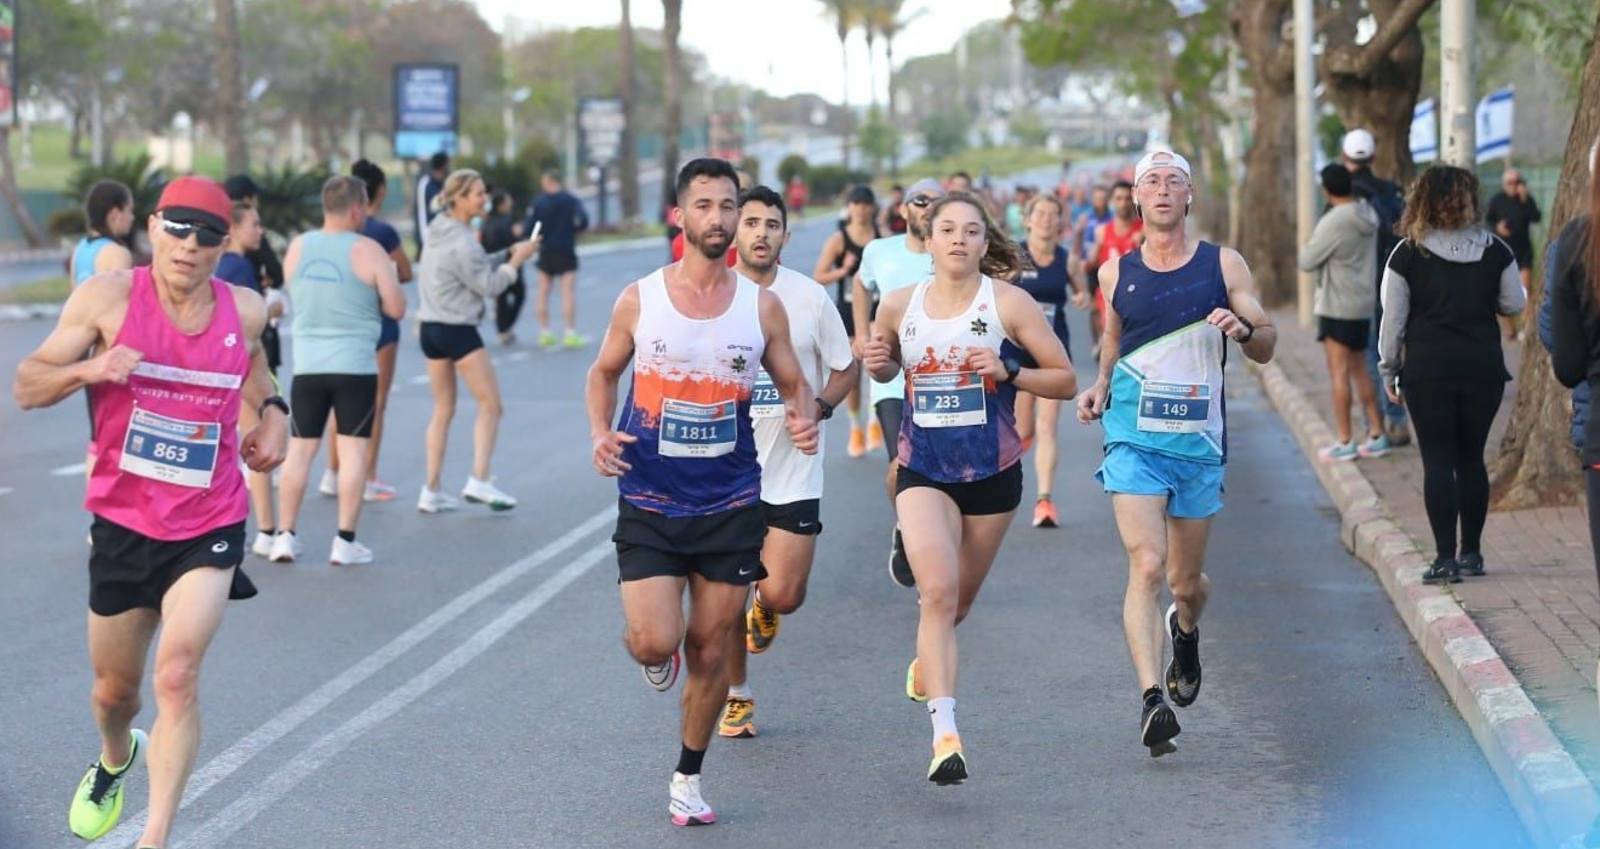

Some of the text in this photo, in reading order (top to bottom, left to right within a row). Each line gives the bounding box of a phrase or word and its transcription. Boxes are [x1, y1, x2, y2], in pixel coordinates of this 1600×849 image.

[752, 388, 780, 402] 723
[935, 395, 960, 409] 233
[1162, 403, 1188, 416] 149
[680, 425, 718, 441] 1811
[153, 442, 188, 463] 863
